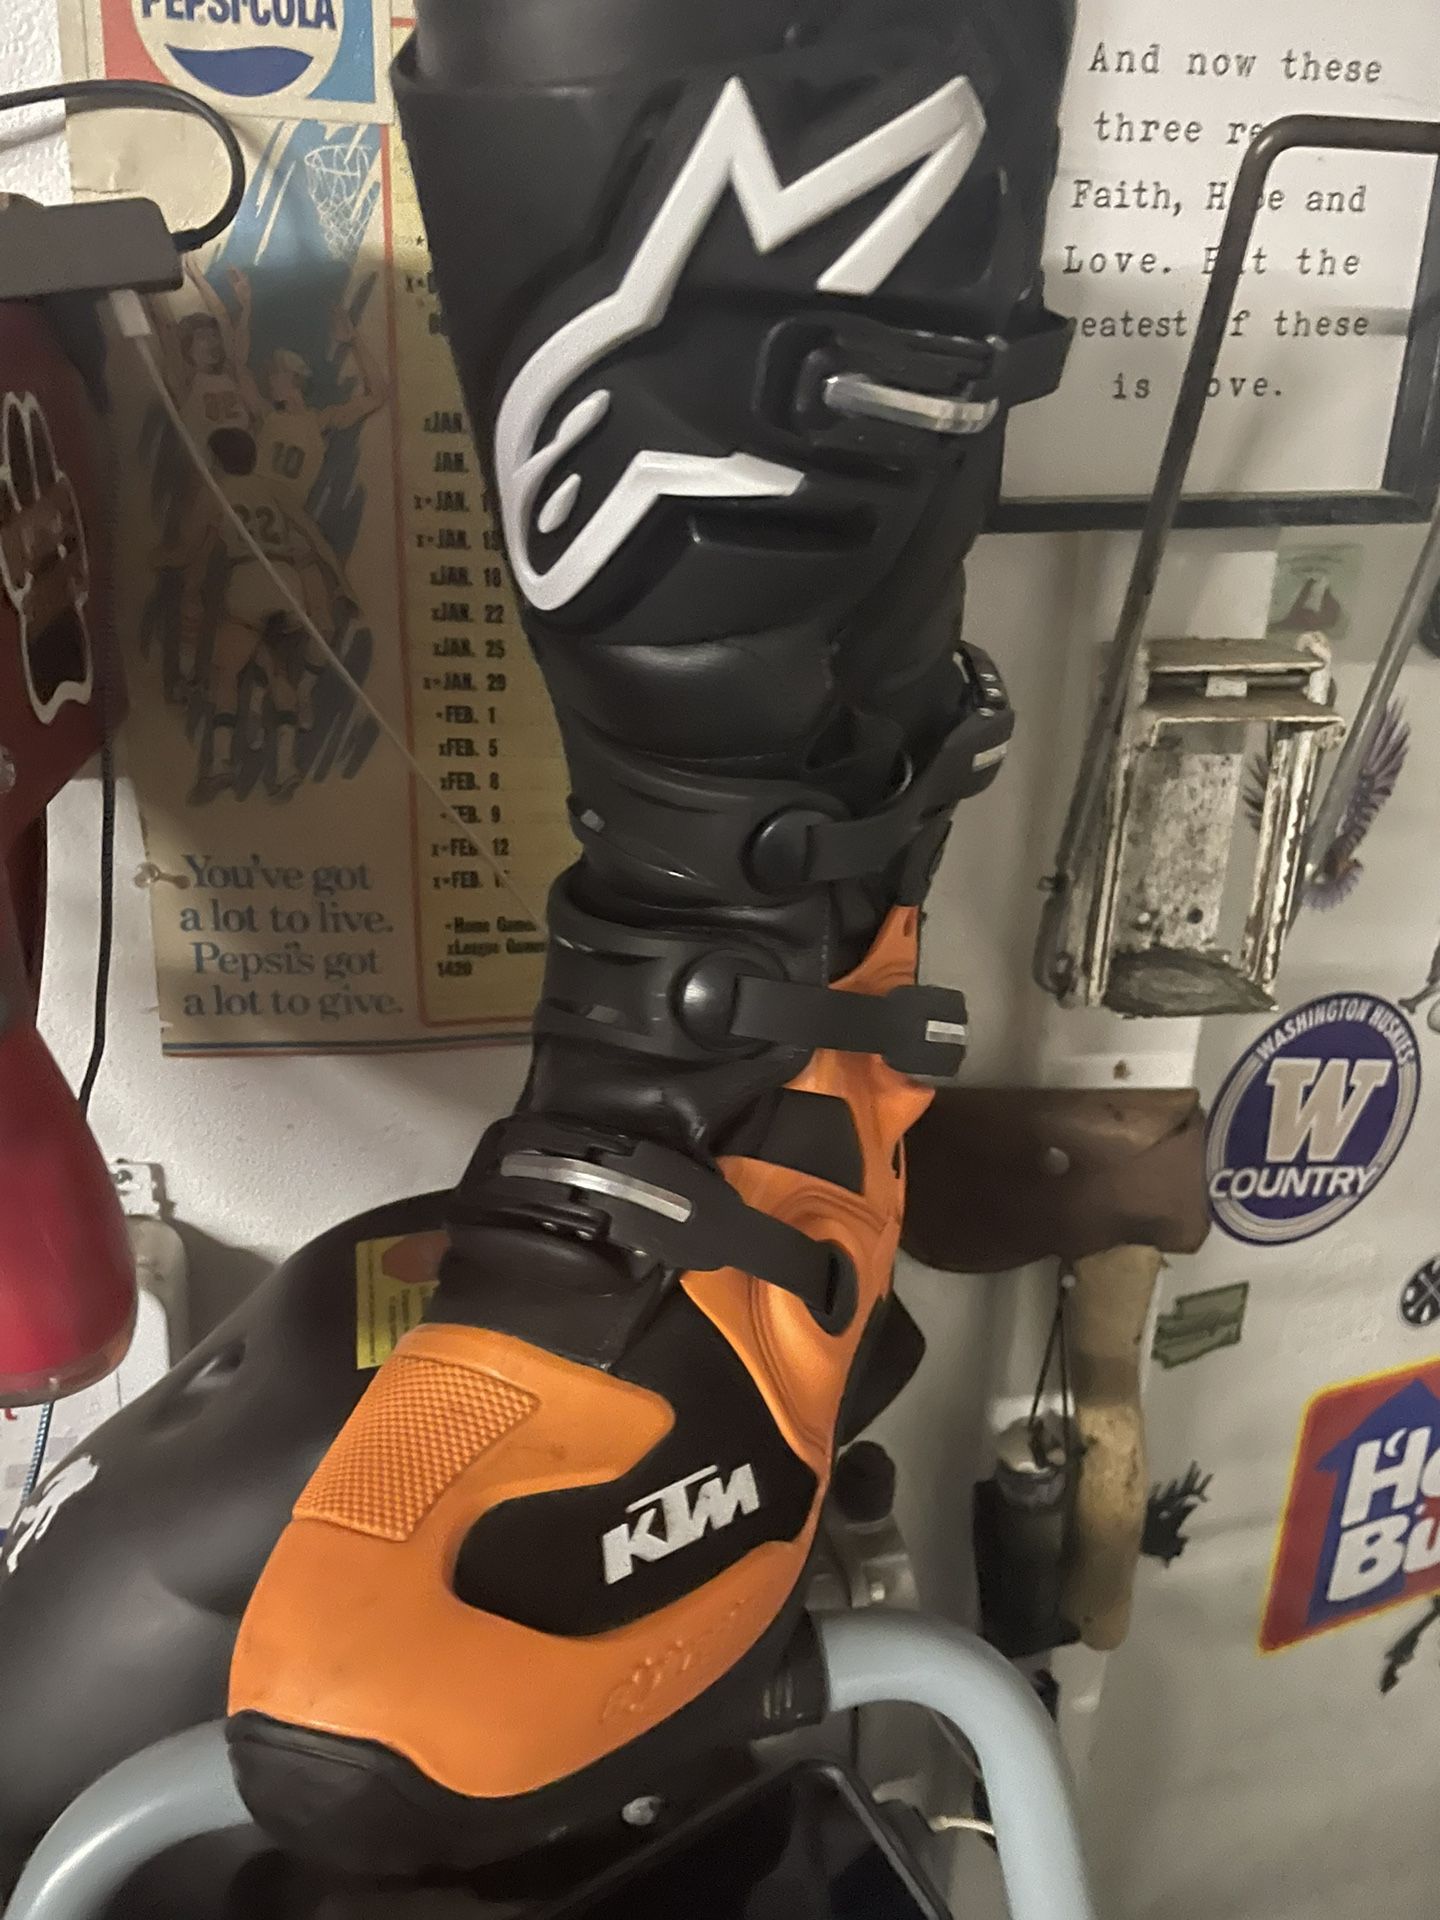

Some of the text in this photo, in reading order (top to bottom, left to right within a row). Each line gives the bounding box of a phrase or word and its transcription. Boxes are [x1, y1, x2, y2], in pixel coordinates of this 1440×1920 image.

[1088, 43, 1383, 83] And now these
[1094, 112, 1203, 143] three
[1071, 179, 1367, 215] Faith, He and
[1063, 246, 1361, 275] Love. Bt the
[1273, 309, 1369, 337] these
[1112, 373, 1282, 399] is ove.
[181, 853, 372, 897] You've got
[180, 898, 395, 934] a lot to live.
[323, 949, 380, 980] got
[183, 983, 404, 1021] a lot to give.
[1255, 998, 1416, 1067] WASHINGTON HUSKIES
[1266, 1056, 1393, 1163] W
[1209, 1165, 1378, 1200] COUNTRY
[602, 1463, 760, 1585] KTM
